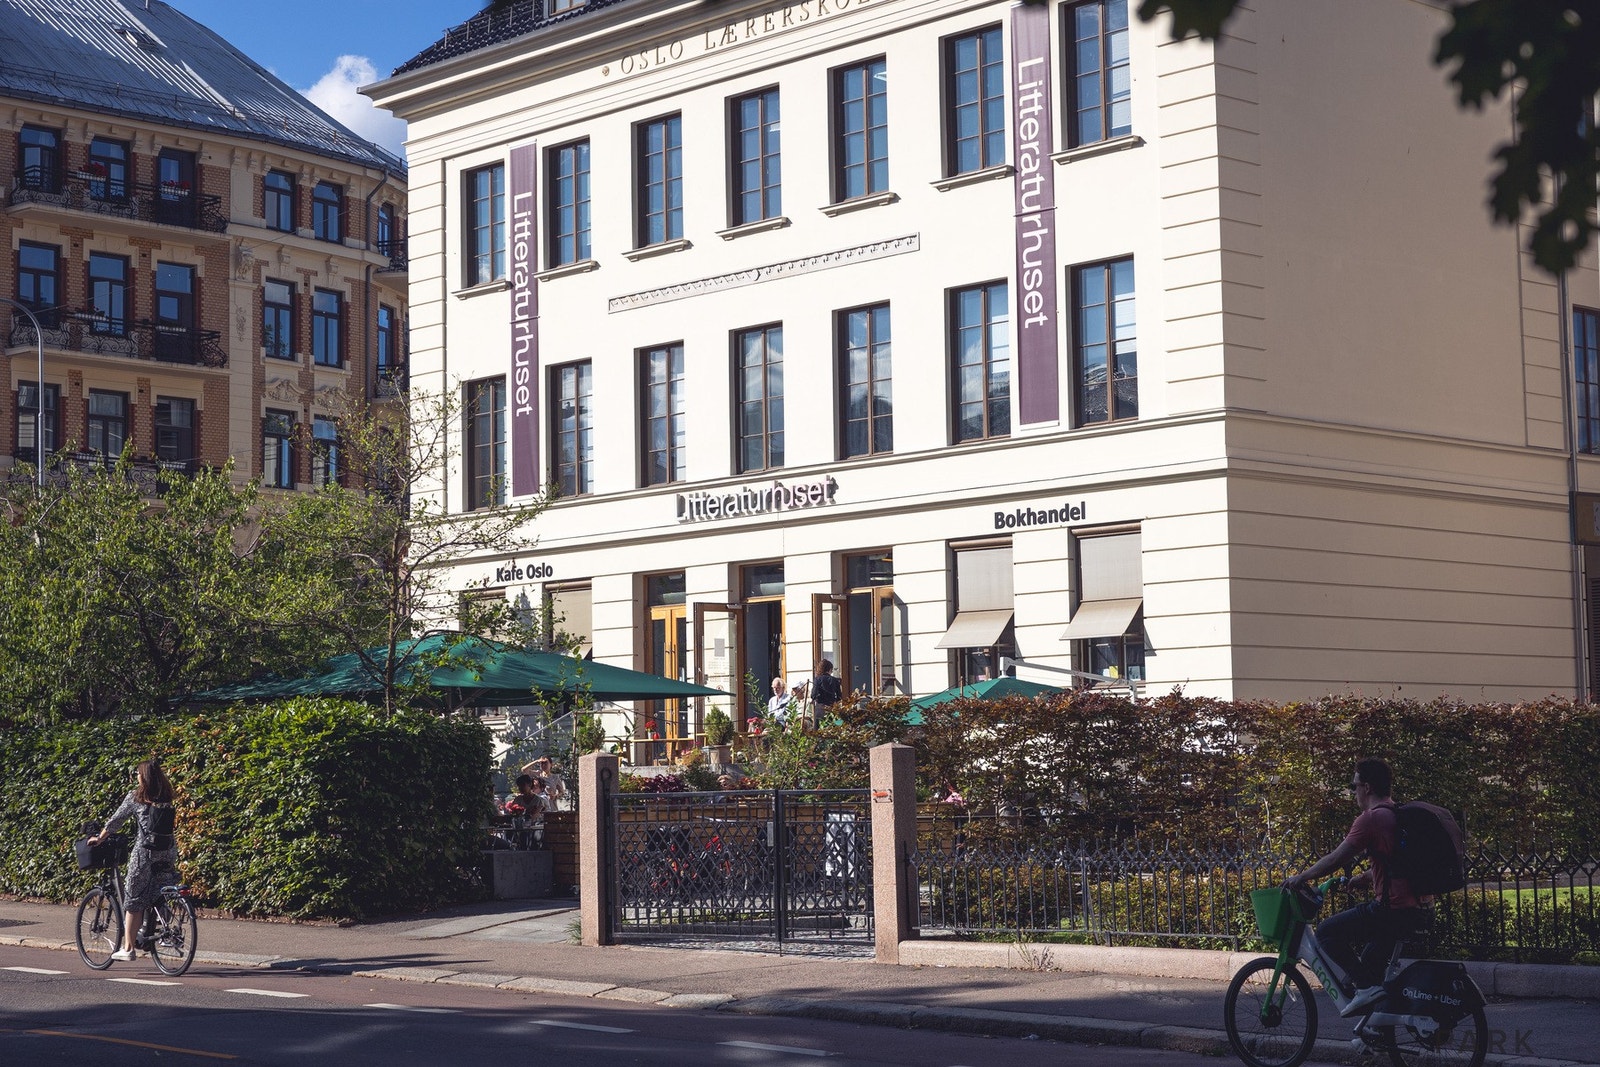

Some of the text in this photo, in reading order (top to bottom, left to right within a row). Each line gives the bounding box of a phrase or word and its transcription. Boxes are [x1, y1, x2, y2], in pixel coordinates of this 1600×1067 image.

[620, 0, 871, 75] OSLO LÆRERSK
[1018, 57, 1049, 329] Litteraturhuset
[513, 191, 534, 418] Litteraturhuset
[676, 474, 840, 525] Litteraturhuset
[994, 501, 1086, 529] Bokhandel
[496, 562, 553, 582] Kafe Oslo
[1311, 957, 1339, 1001] Lime
[1440, 995, 1462, 1006] Uber
